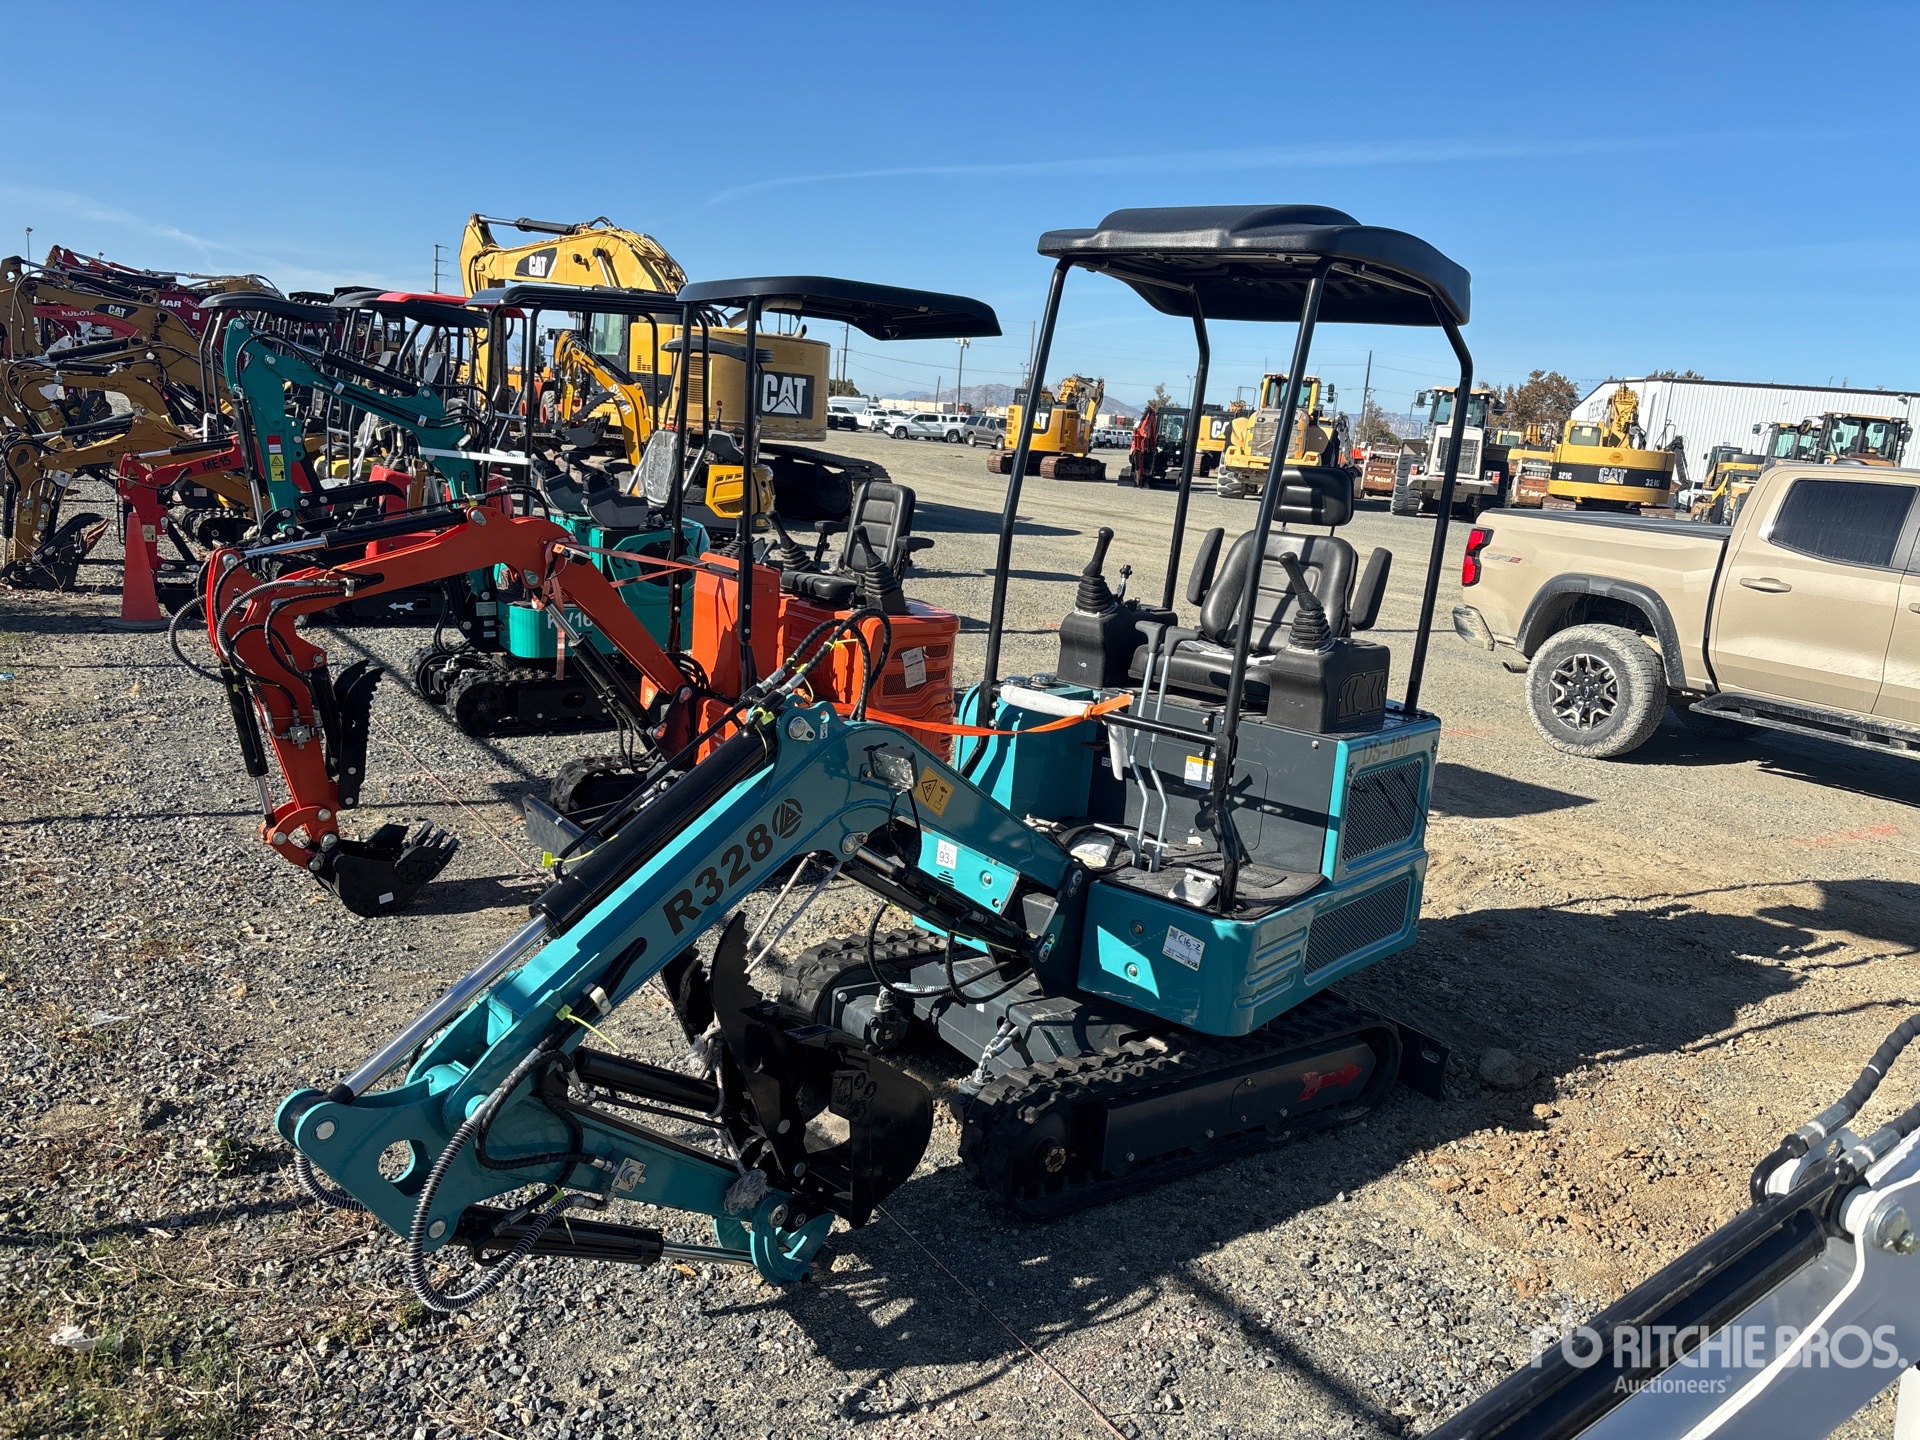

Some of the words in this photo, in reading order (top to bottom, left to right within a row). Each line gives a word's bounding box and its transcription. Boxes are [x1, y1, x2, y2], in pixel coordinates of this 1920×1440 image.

[529, 255, 547, 276] CAT
[108, 304, 127, 318] CAT
[762, 374, 807, 415] CAT
[201, 455, 232, 472] ME15
[1558, 471, 1573, 481] 321C
[1598, 467, 1628, 485] CAT
[1362, 735, 1411, 765] DS-180
[939, 851, 950, 864] 93
[662, 823, 774, 936] R328
